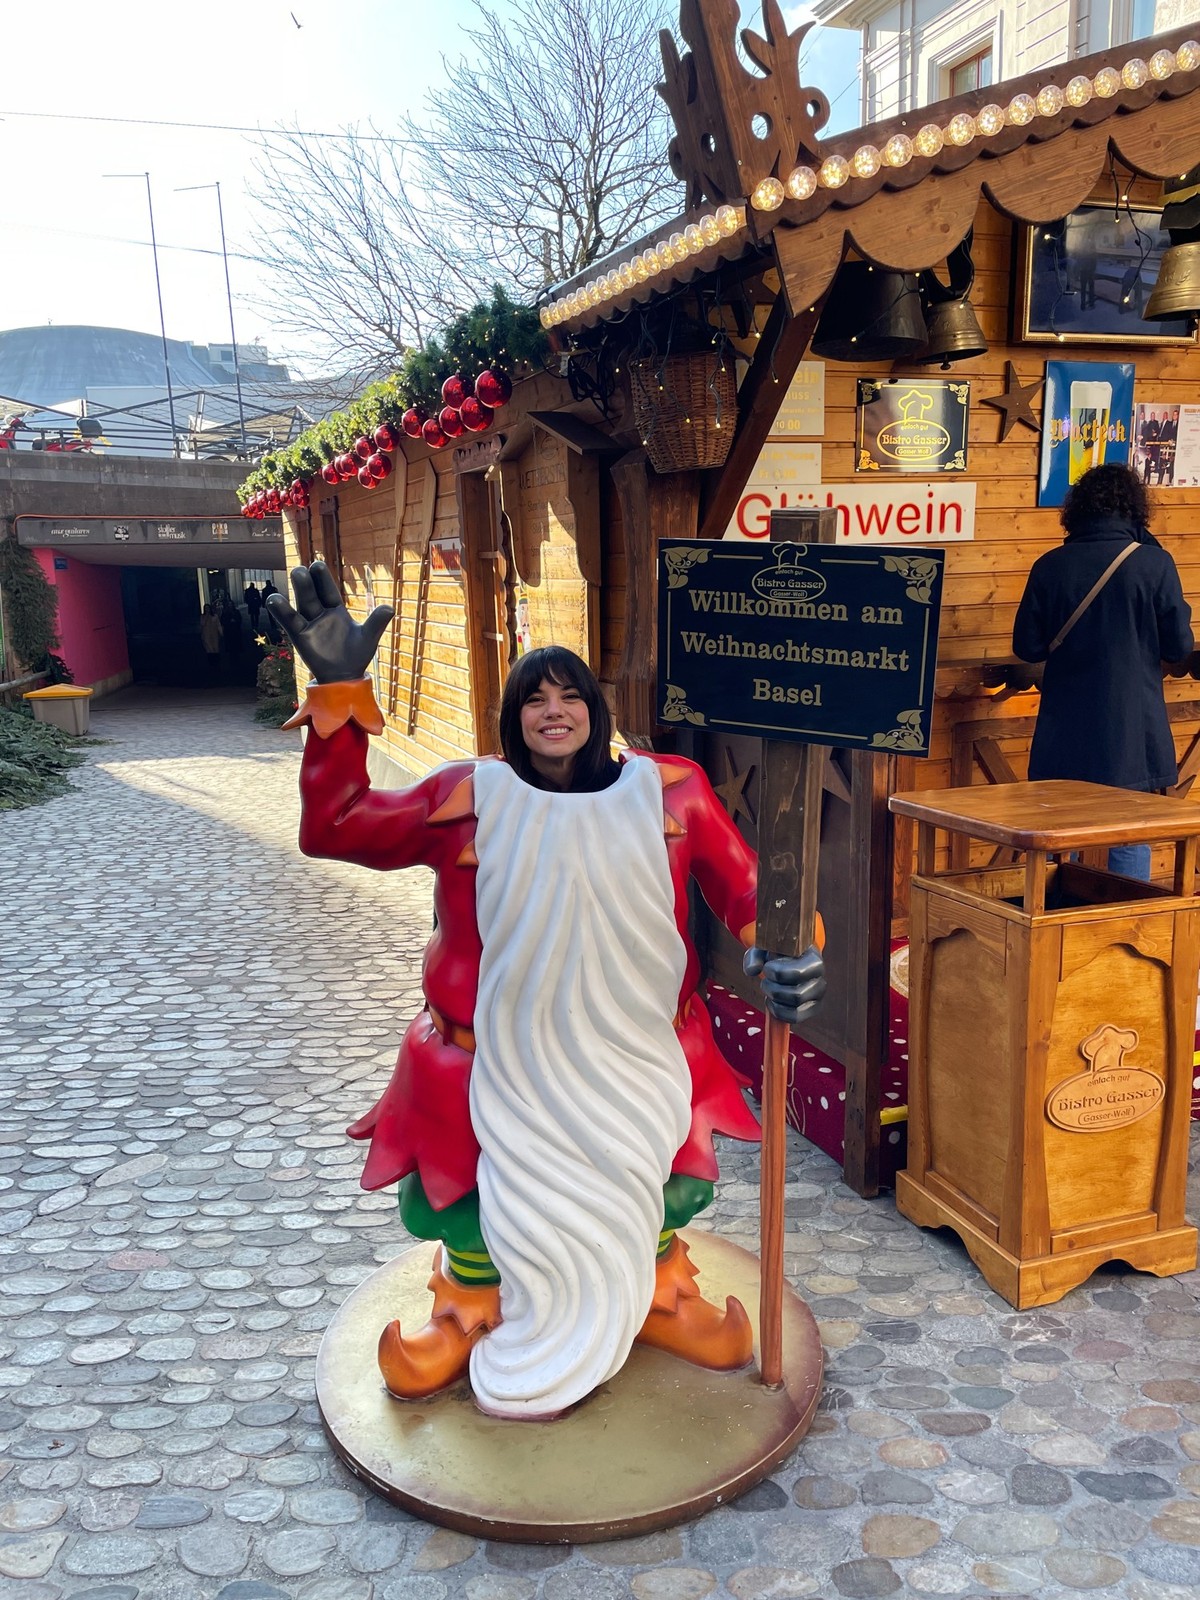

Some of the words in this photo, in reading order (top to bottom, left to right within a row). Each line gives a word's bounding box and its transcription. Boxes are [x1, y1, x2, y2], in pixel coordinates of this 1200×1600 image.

[882, 434, 912, 445] Bistro
[912, 434, 947, 445] Gasser
[736, 491, 962, 539] Ghwein
[756, 577, 786, 588] Bistro
[787, 579, 823, 589] Gasser
[688, 589, 848, 622] Willkommen
[861, 605, 904, 625] am
[680, 631, 910, 671] Weihnachtsmarkt
[752, 678, 823, 706] Basel
[1087, 1074, 1115, 1087] einfach
[1117, 1074, 1131, 1082] gut
[1058, 1096, 1103, 1111] Bistro
[1106, 1088, 1159, 1104] Gasser
